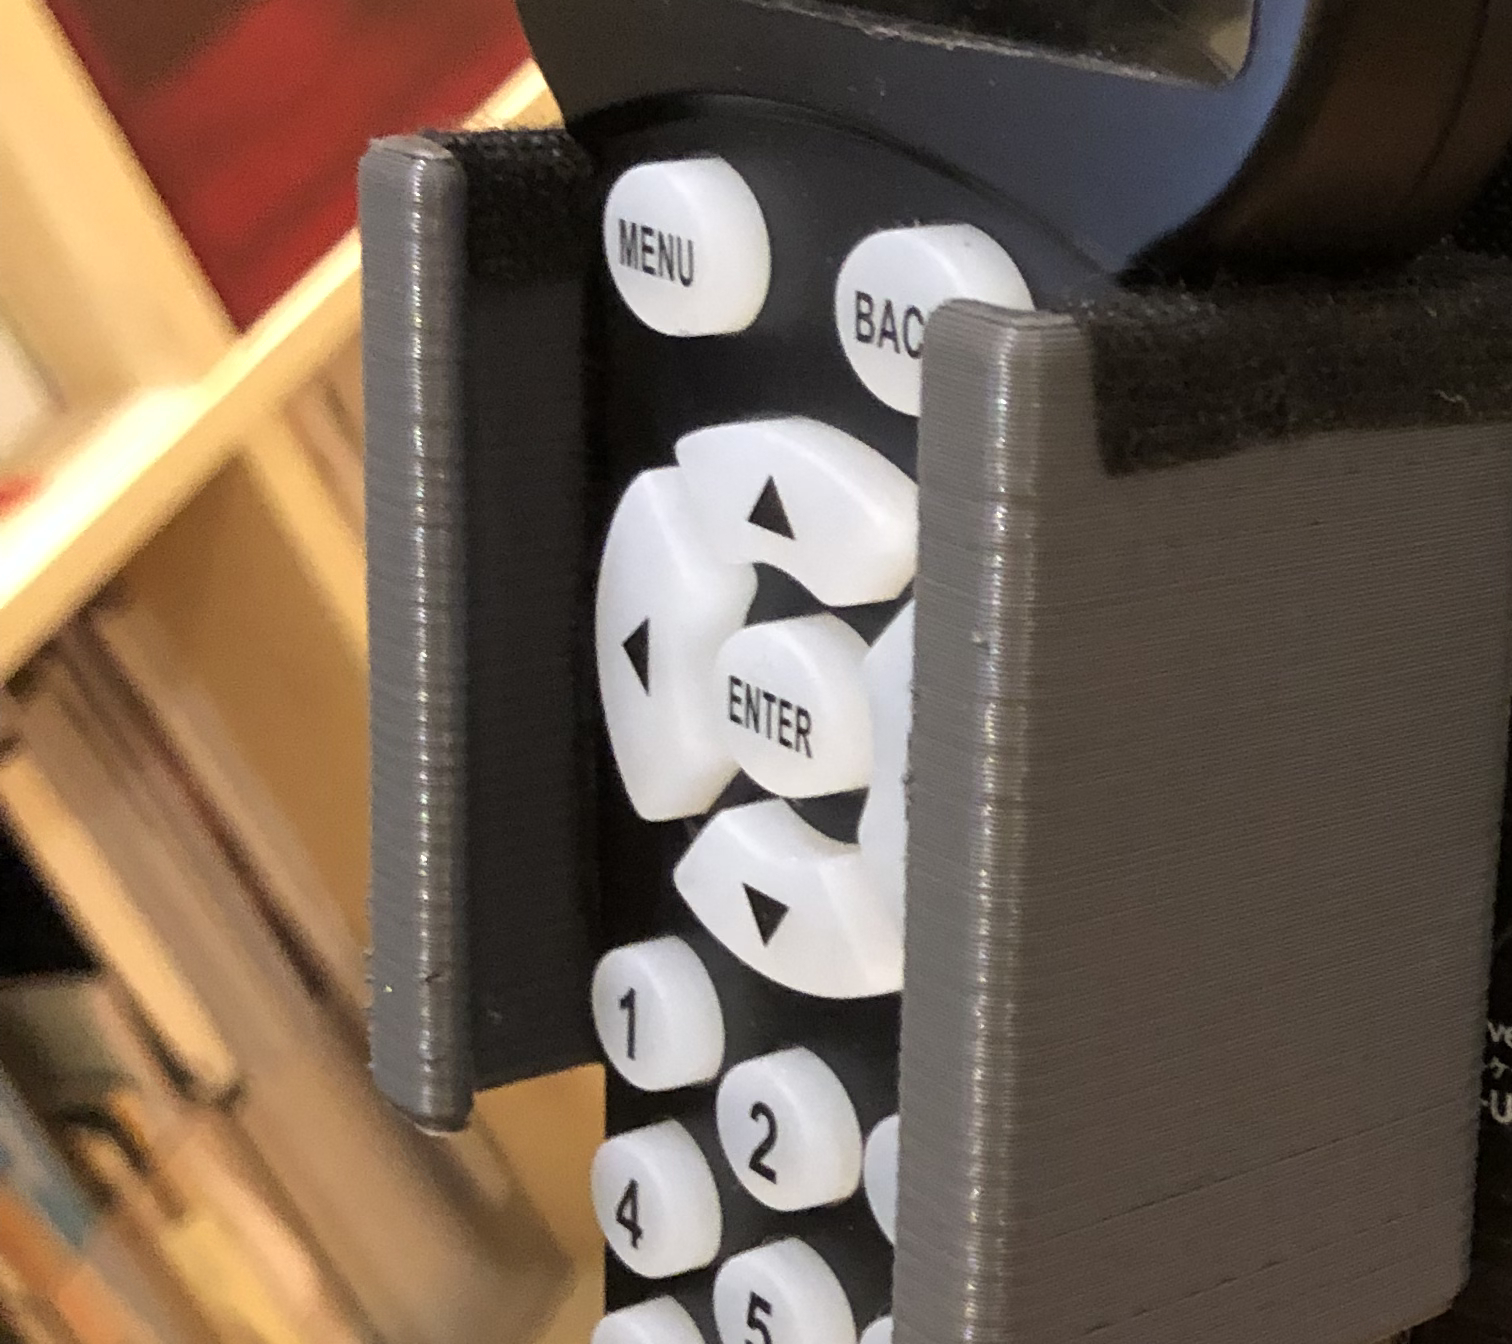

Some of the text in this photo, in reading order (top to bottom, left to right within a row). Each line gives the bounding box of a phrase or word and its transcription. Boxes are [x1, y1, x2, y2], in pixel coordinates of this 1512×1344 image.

[618, 218, 694, 287] MENU
[854, 290, 925, 359] BAC
[728, 674, 813, 758] ENTER
[618, 987, 636, 1061] 1
[749, 1101, 778, 1185] 2
[616, 1178, 643, 1249] 4
